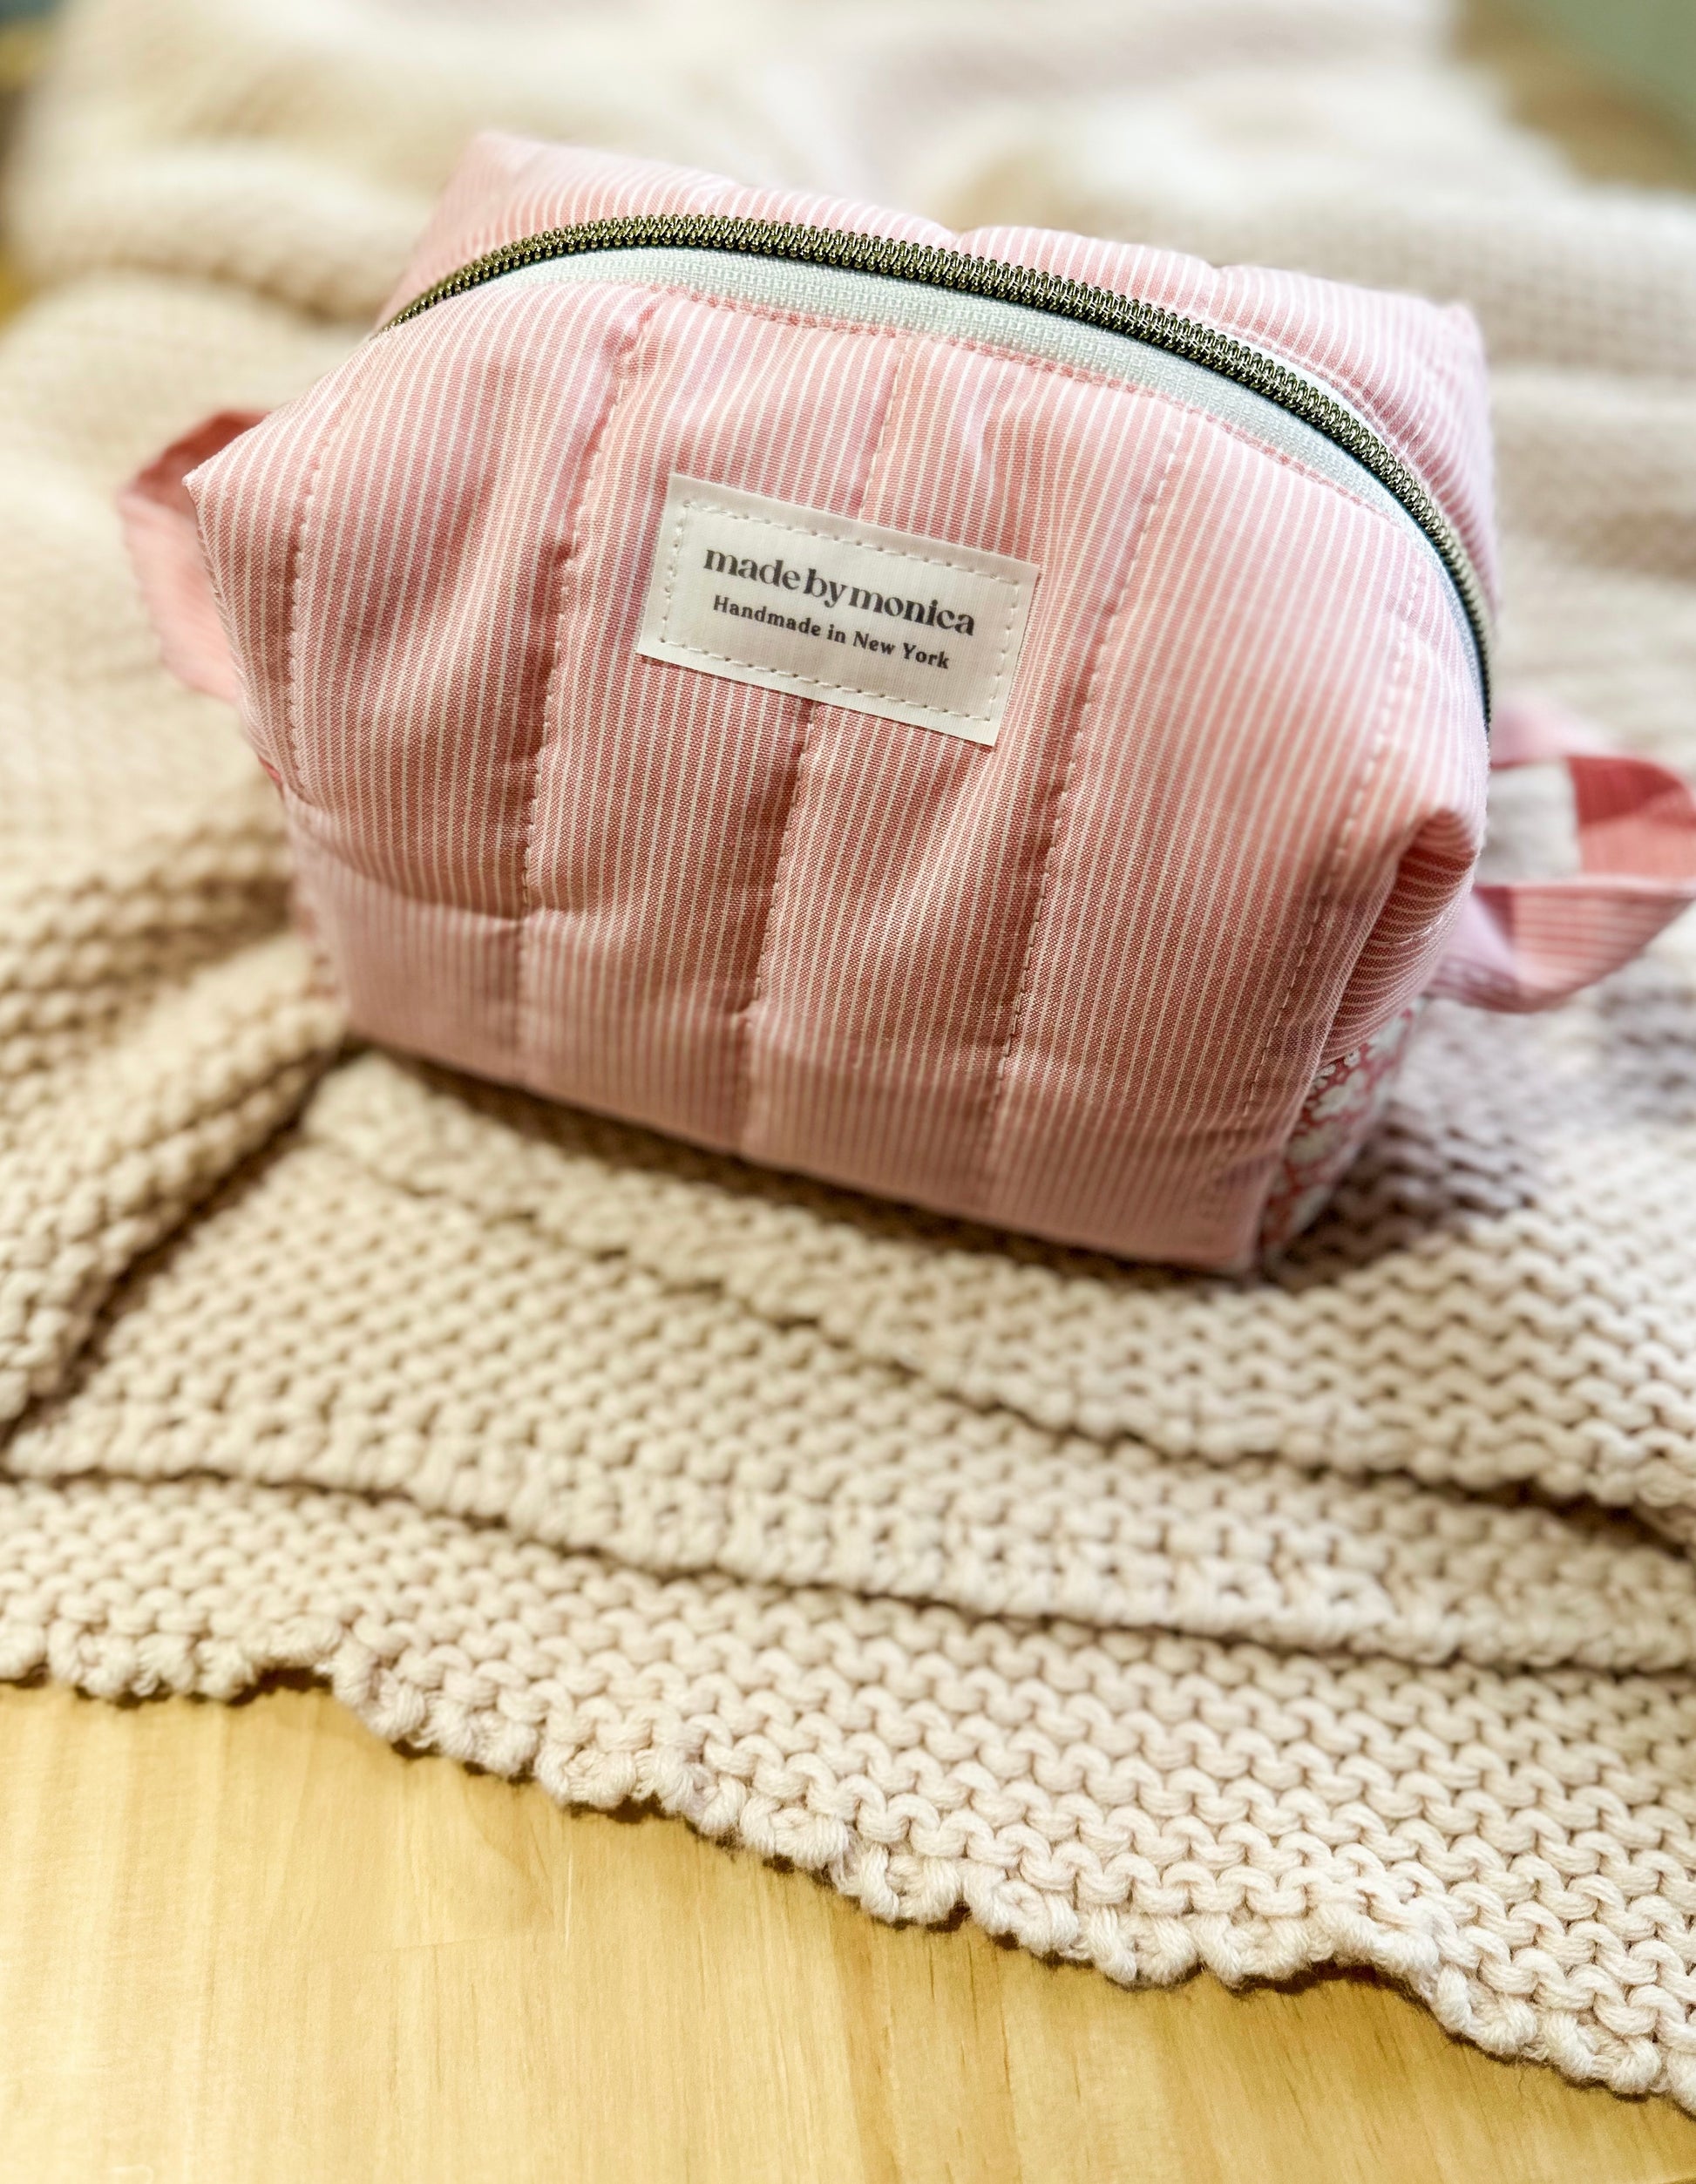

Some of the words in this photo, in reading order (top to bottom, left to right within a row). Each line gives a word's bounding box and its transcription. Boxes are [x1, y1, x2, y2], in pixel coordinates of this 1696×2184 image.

[713, 594, 822, 637] Handmade
[826, 623, 846, 645] in
[852, 630, 897, 655] New
[902, 641, 950, 670] York
